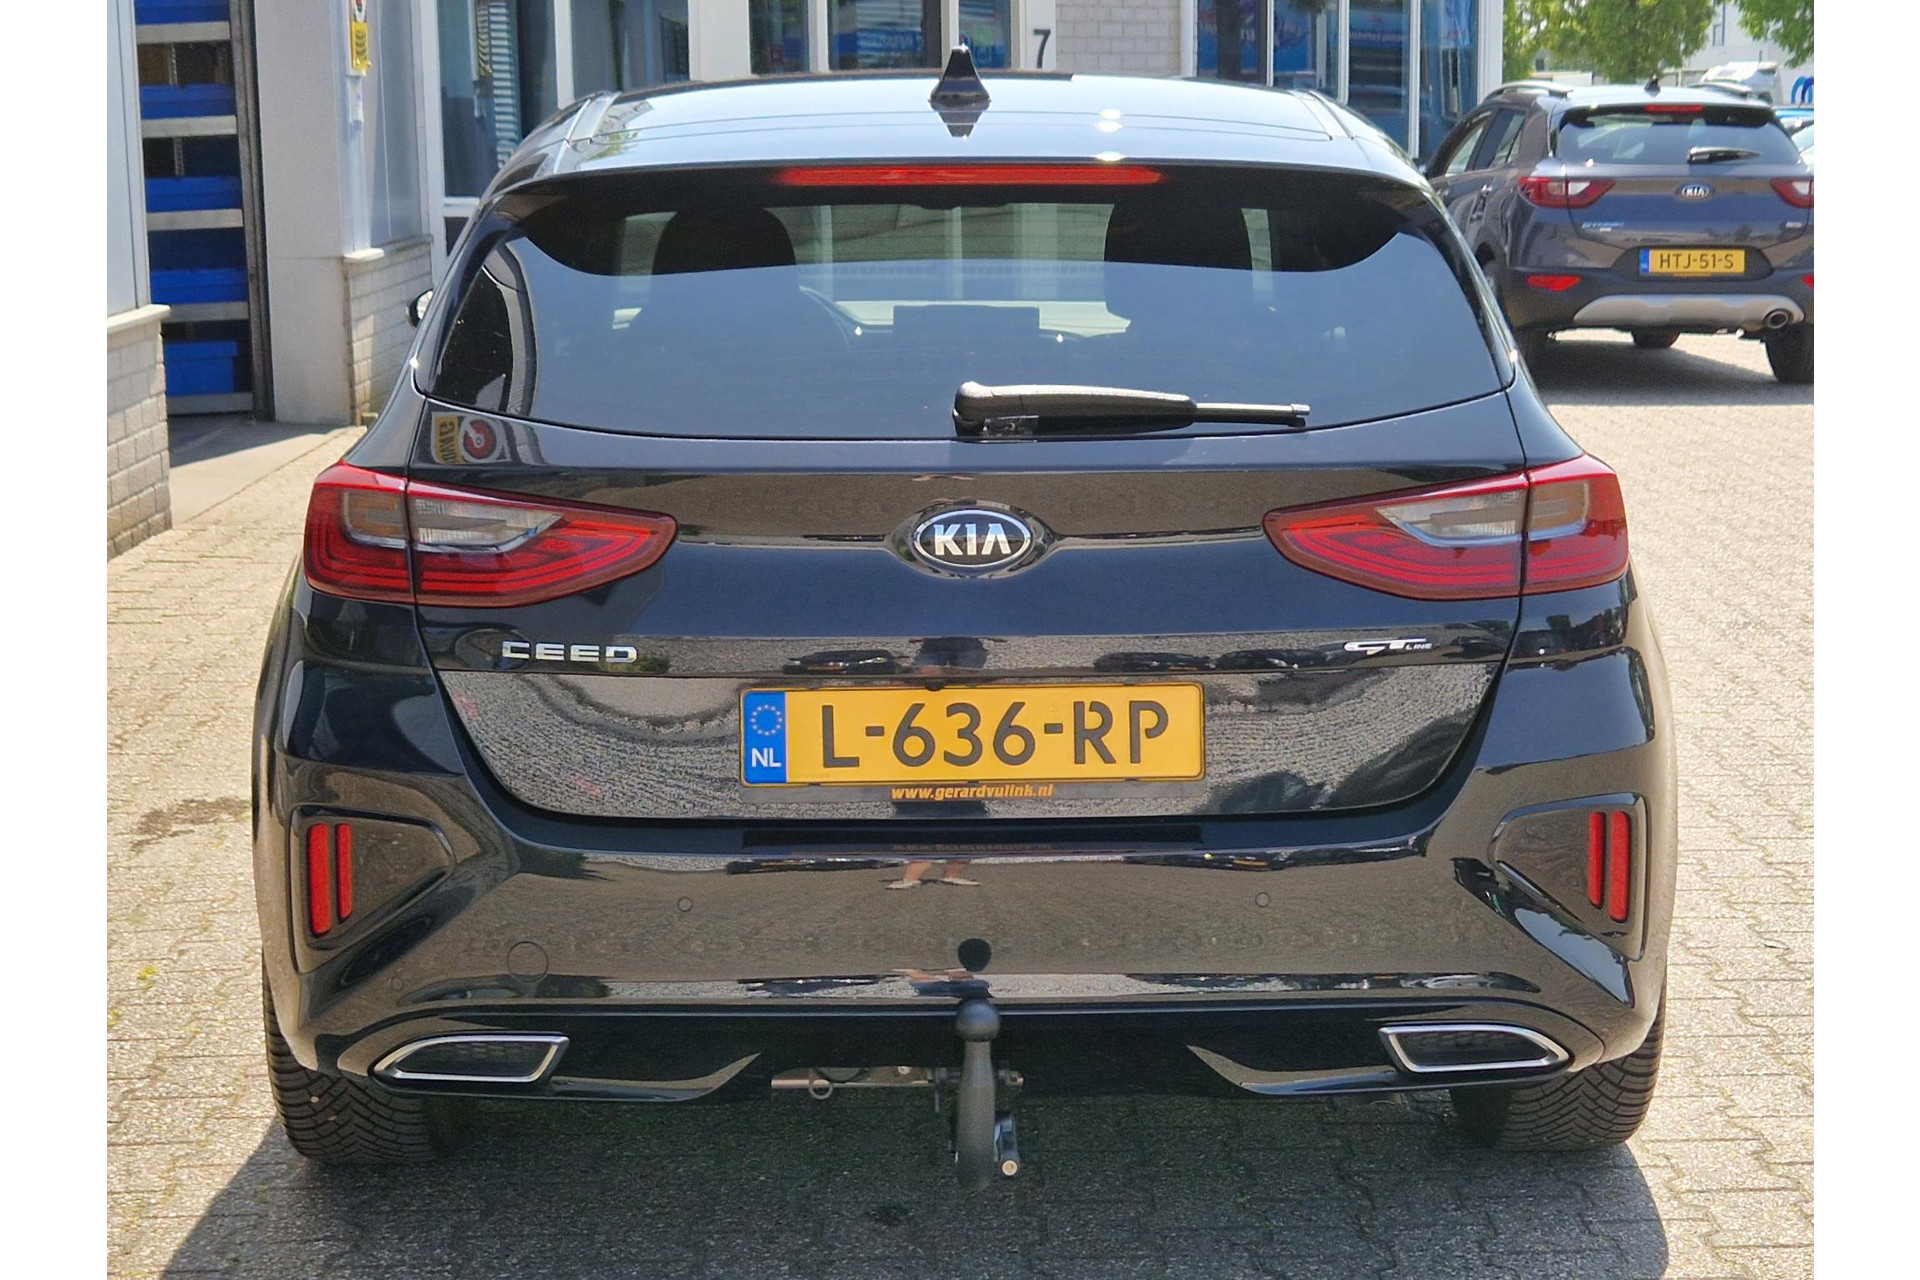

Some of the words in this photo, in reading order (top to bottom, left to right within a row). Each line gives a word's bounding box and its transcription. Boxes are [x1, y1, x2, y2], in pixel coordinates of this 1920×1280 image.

[1033, 29, 1051, 69] 7
[1659, 253, 1734, 269] HTJ-51-S
[933, 523, 1012, 556] KIA
[502, 640, 638, 663] CEED
[1405, 643, 1433, 651] LINE
[821, 700, 1169, 768] L-636-RP
[751, 747, 782, 768] NL
[891, 783, 1055, 801] www.gerardvulink.nl
